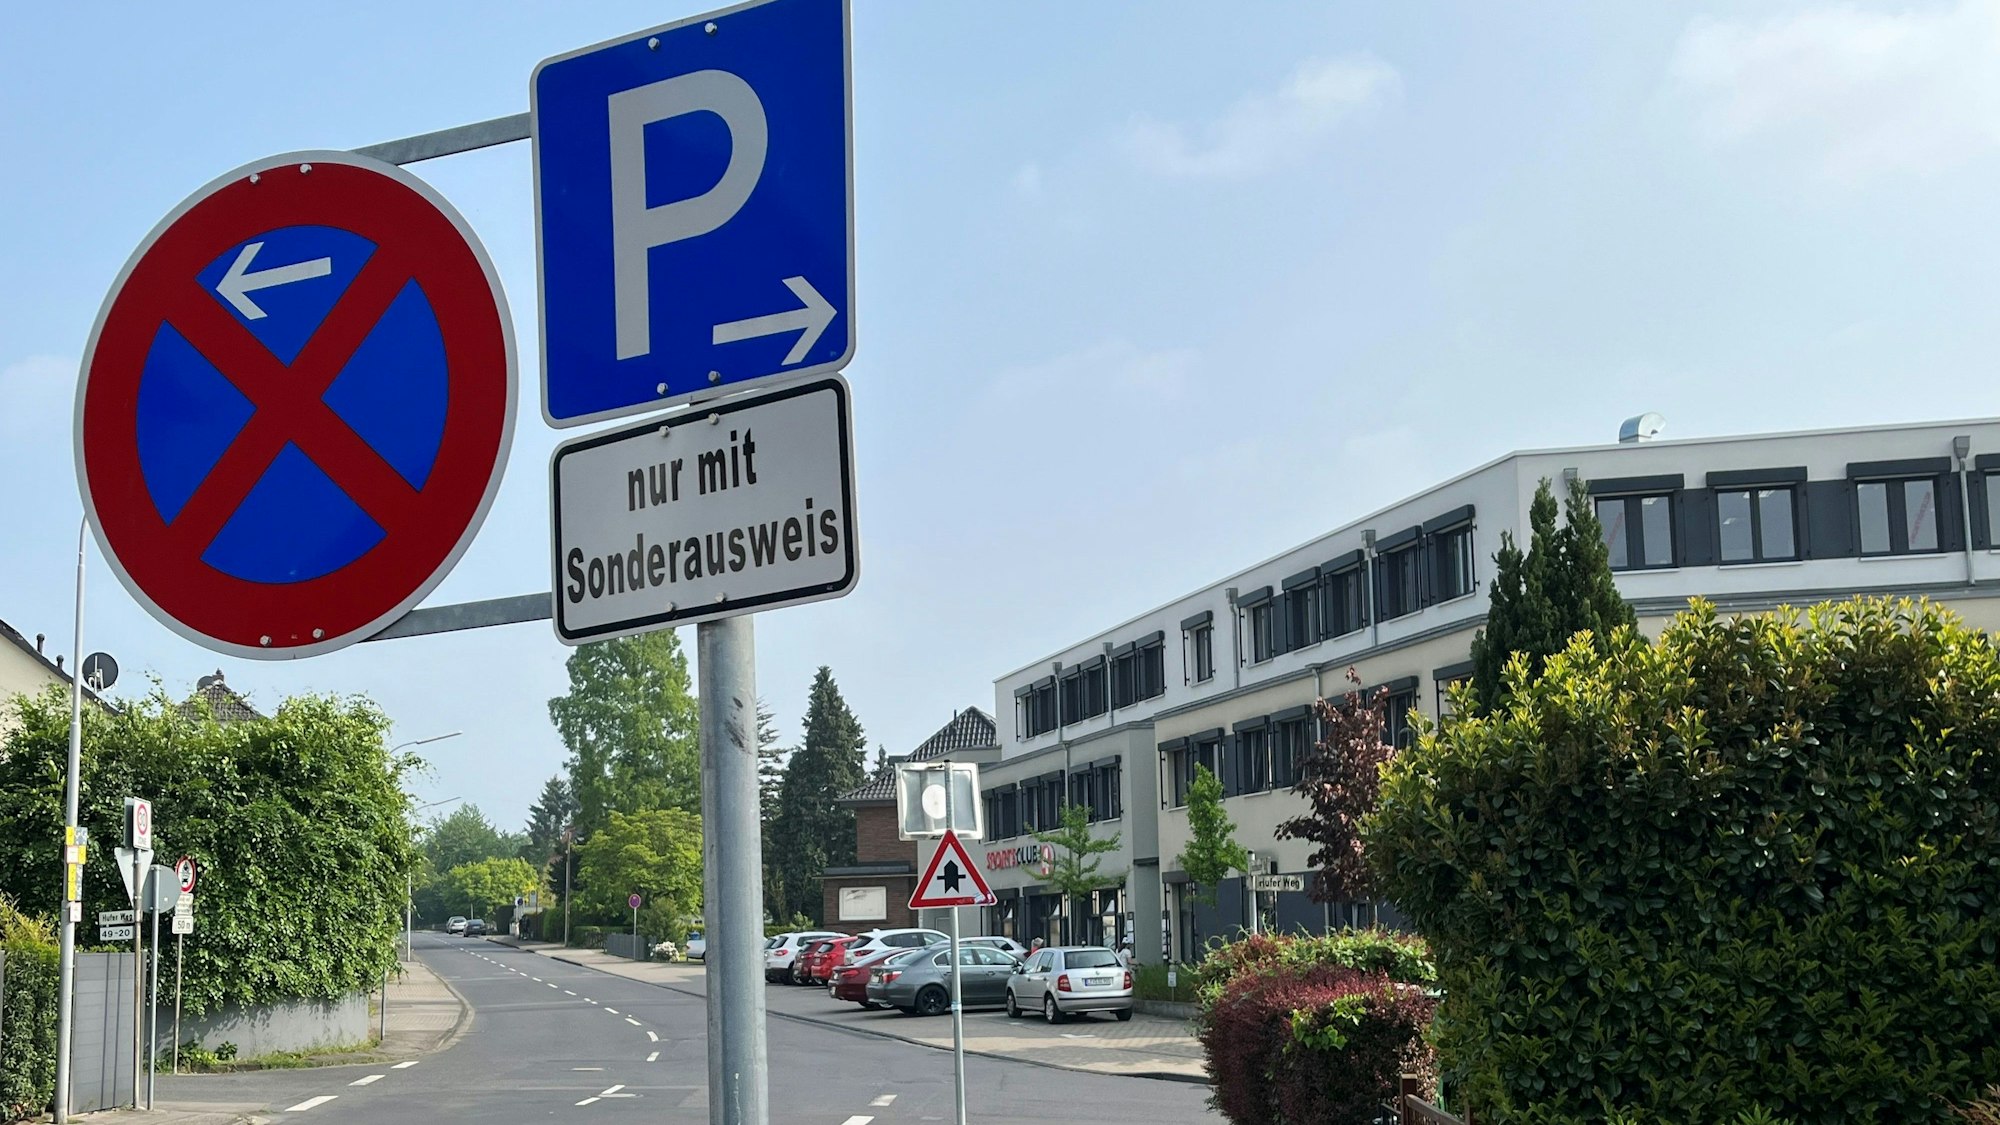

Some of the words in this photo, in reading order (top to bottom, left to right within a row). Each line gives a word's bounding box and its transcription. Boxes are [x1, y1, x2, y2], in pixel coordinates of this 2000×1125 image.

[608, 69, 768, 360] P
[628, 458, 683, 511] nur
[698, 428, 757, 495] mit
[567, 497, 839, 604] Sonderausweis
[1283, 877, 1299, 890] Weg
[102, 913, 118, 922] Hufer
[120, 912, 133, 922] Weg
[178, 920, 185, 930] 50
[102, 929, 130, 938] 49-20
